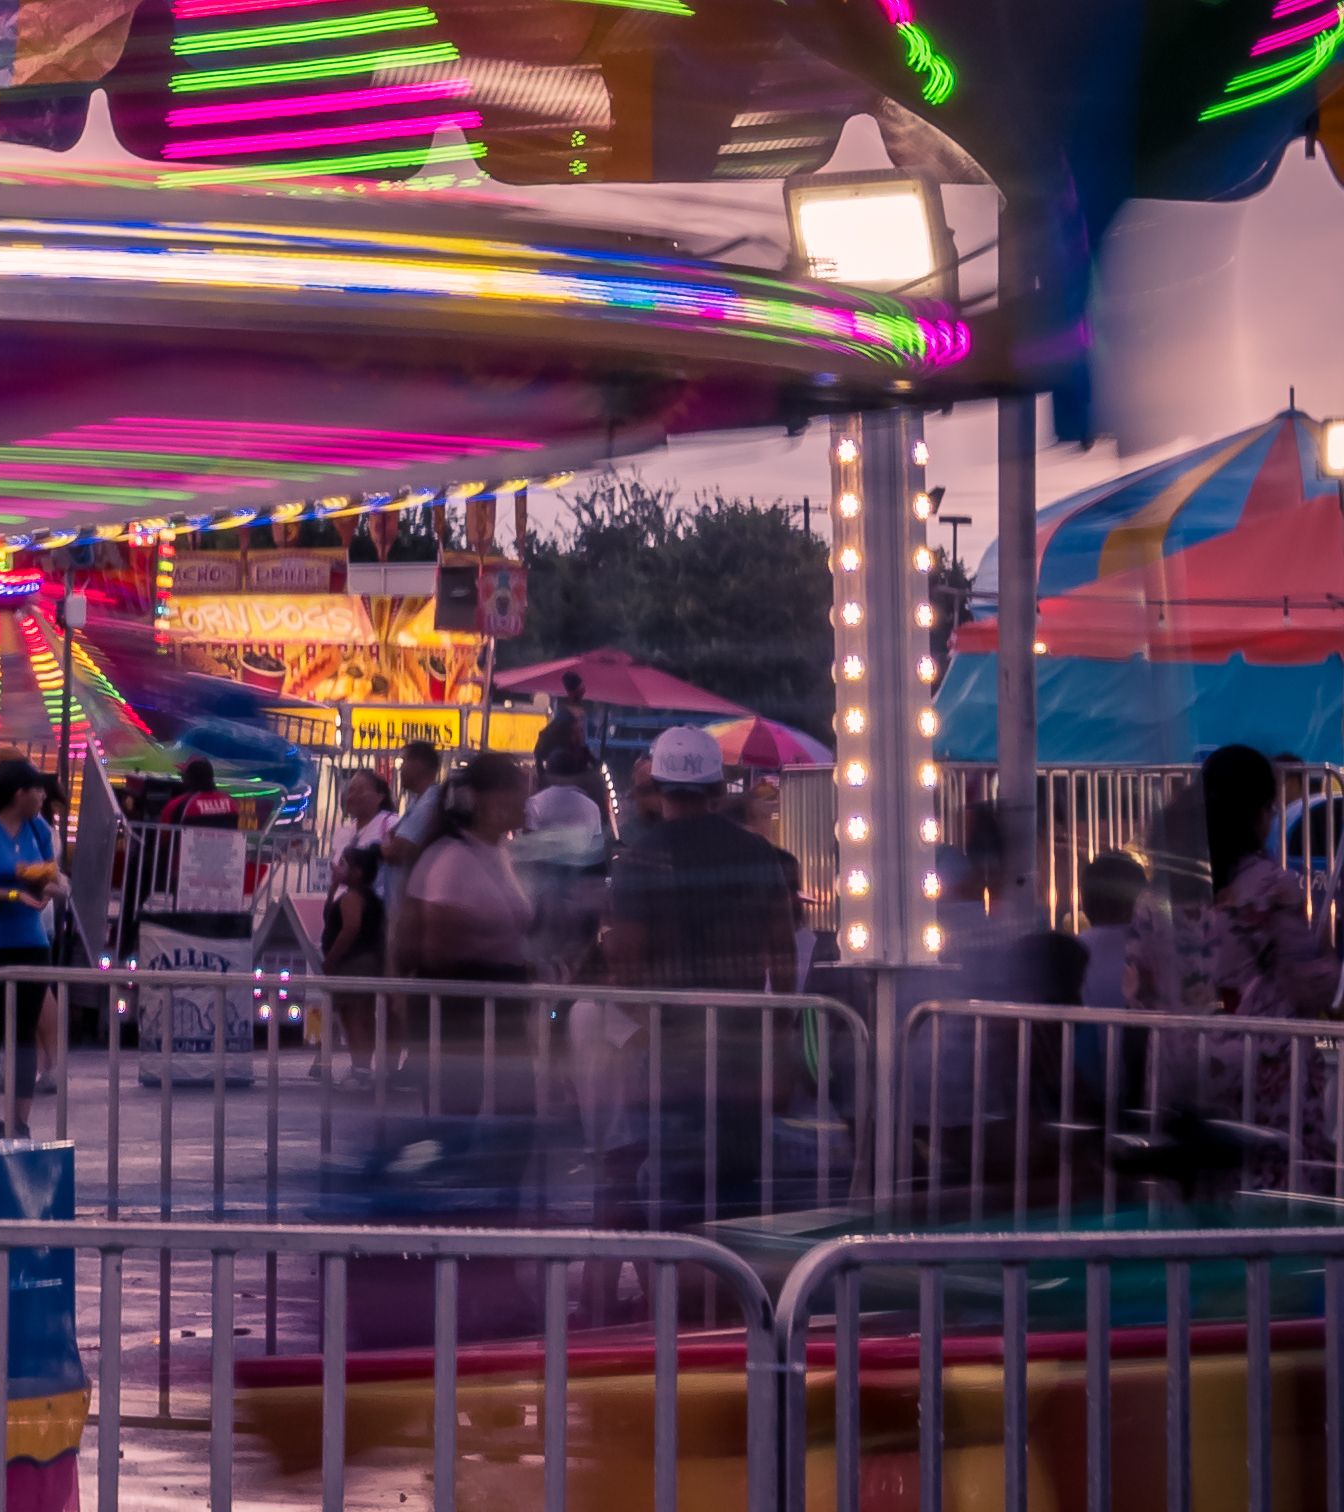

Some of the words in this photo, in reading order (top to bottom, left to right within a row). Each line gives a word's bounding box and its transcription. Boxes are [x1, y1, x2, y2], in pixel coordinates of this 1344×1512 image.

[174, 565, 232, 582] ACHOS
[252, 603, 353, 634] DOGS
[150, 948, 231, 973] TALLEY
